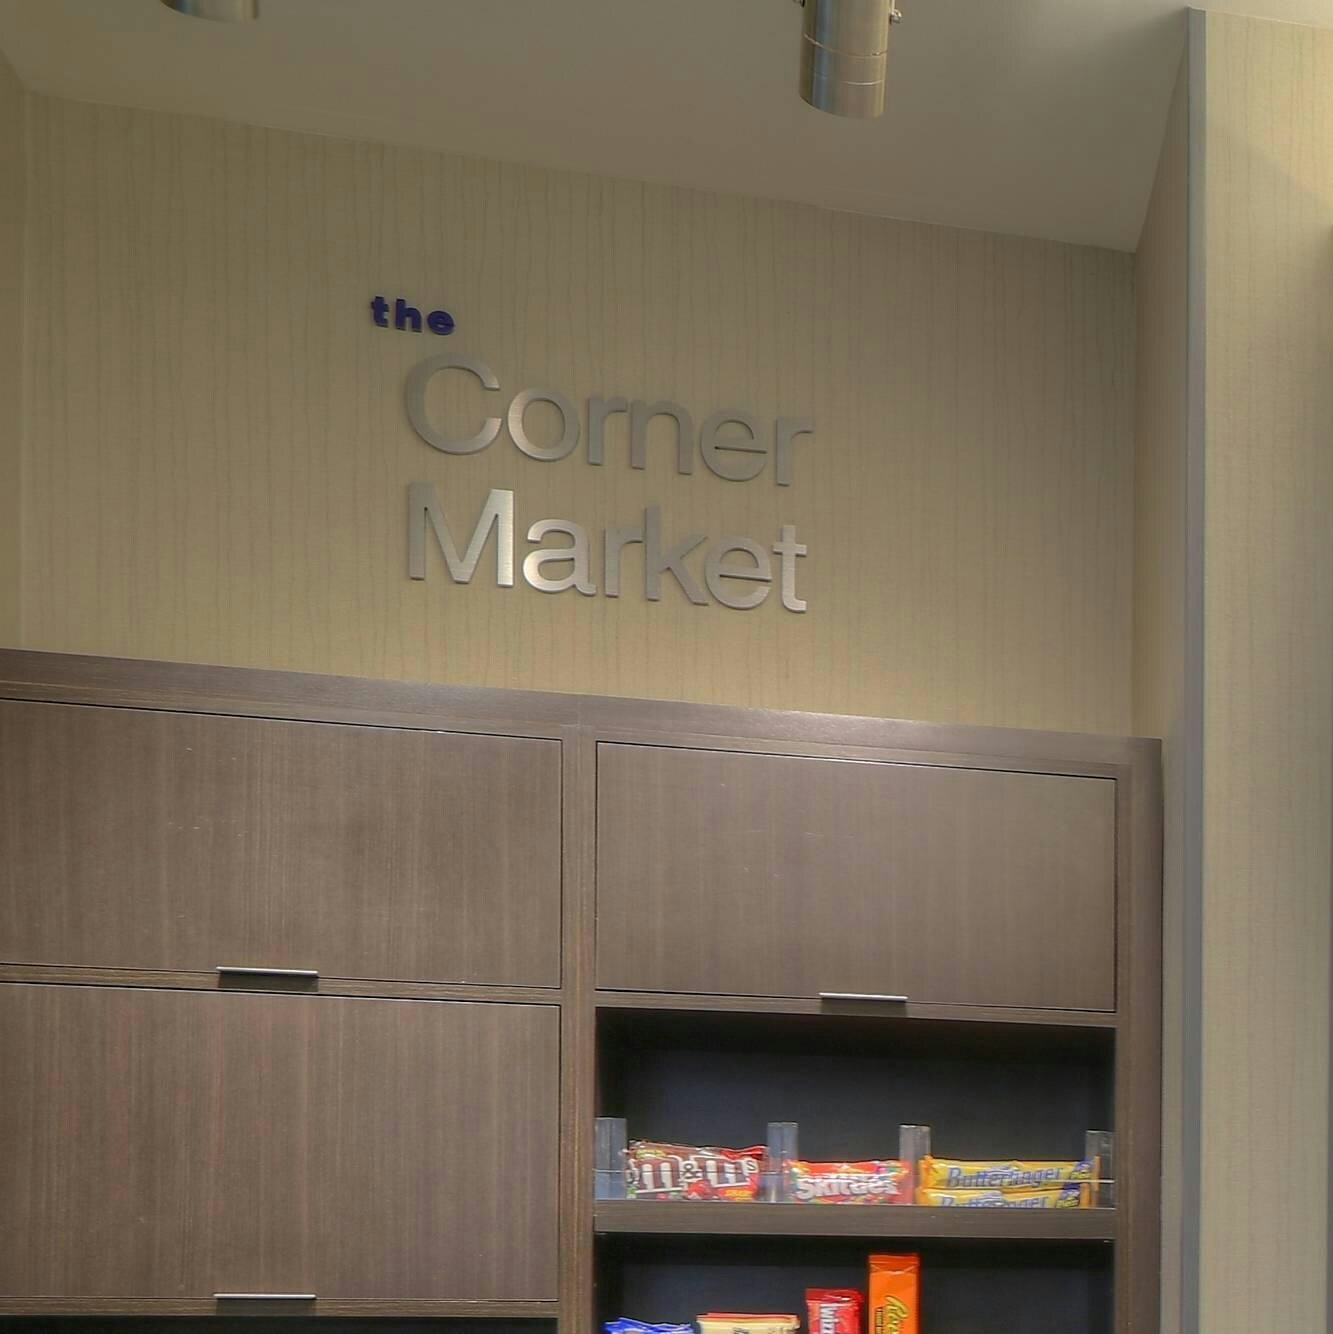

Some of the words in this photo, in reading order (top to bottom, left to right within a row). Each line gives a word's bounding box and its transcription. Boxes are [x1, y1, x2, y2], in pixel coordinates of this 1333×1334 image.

[371, 296, 455, 335] the
[405, 352, 814, 487] Corner
[408, 481, 808, 613] Market
